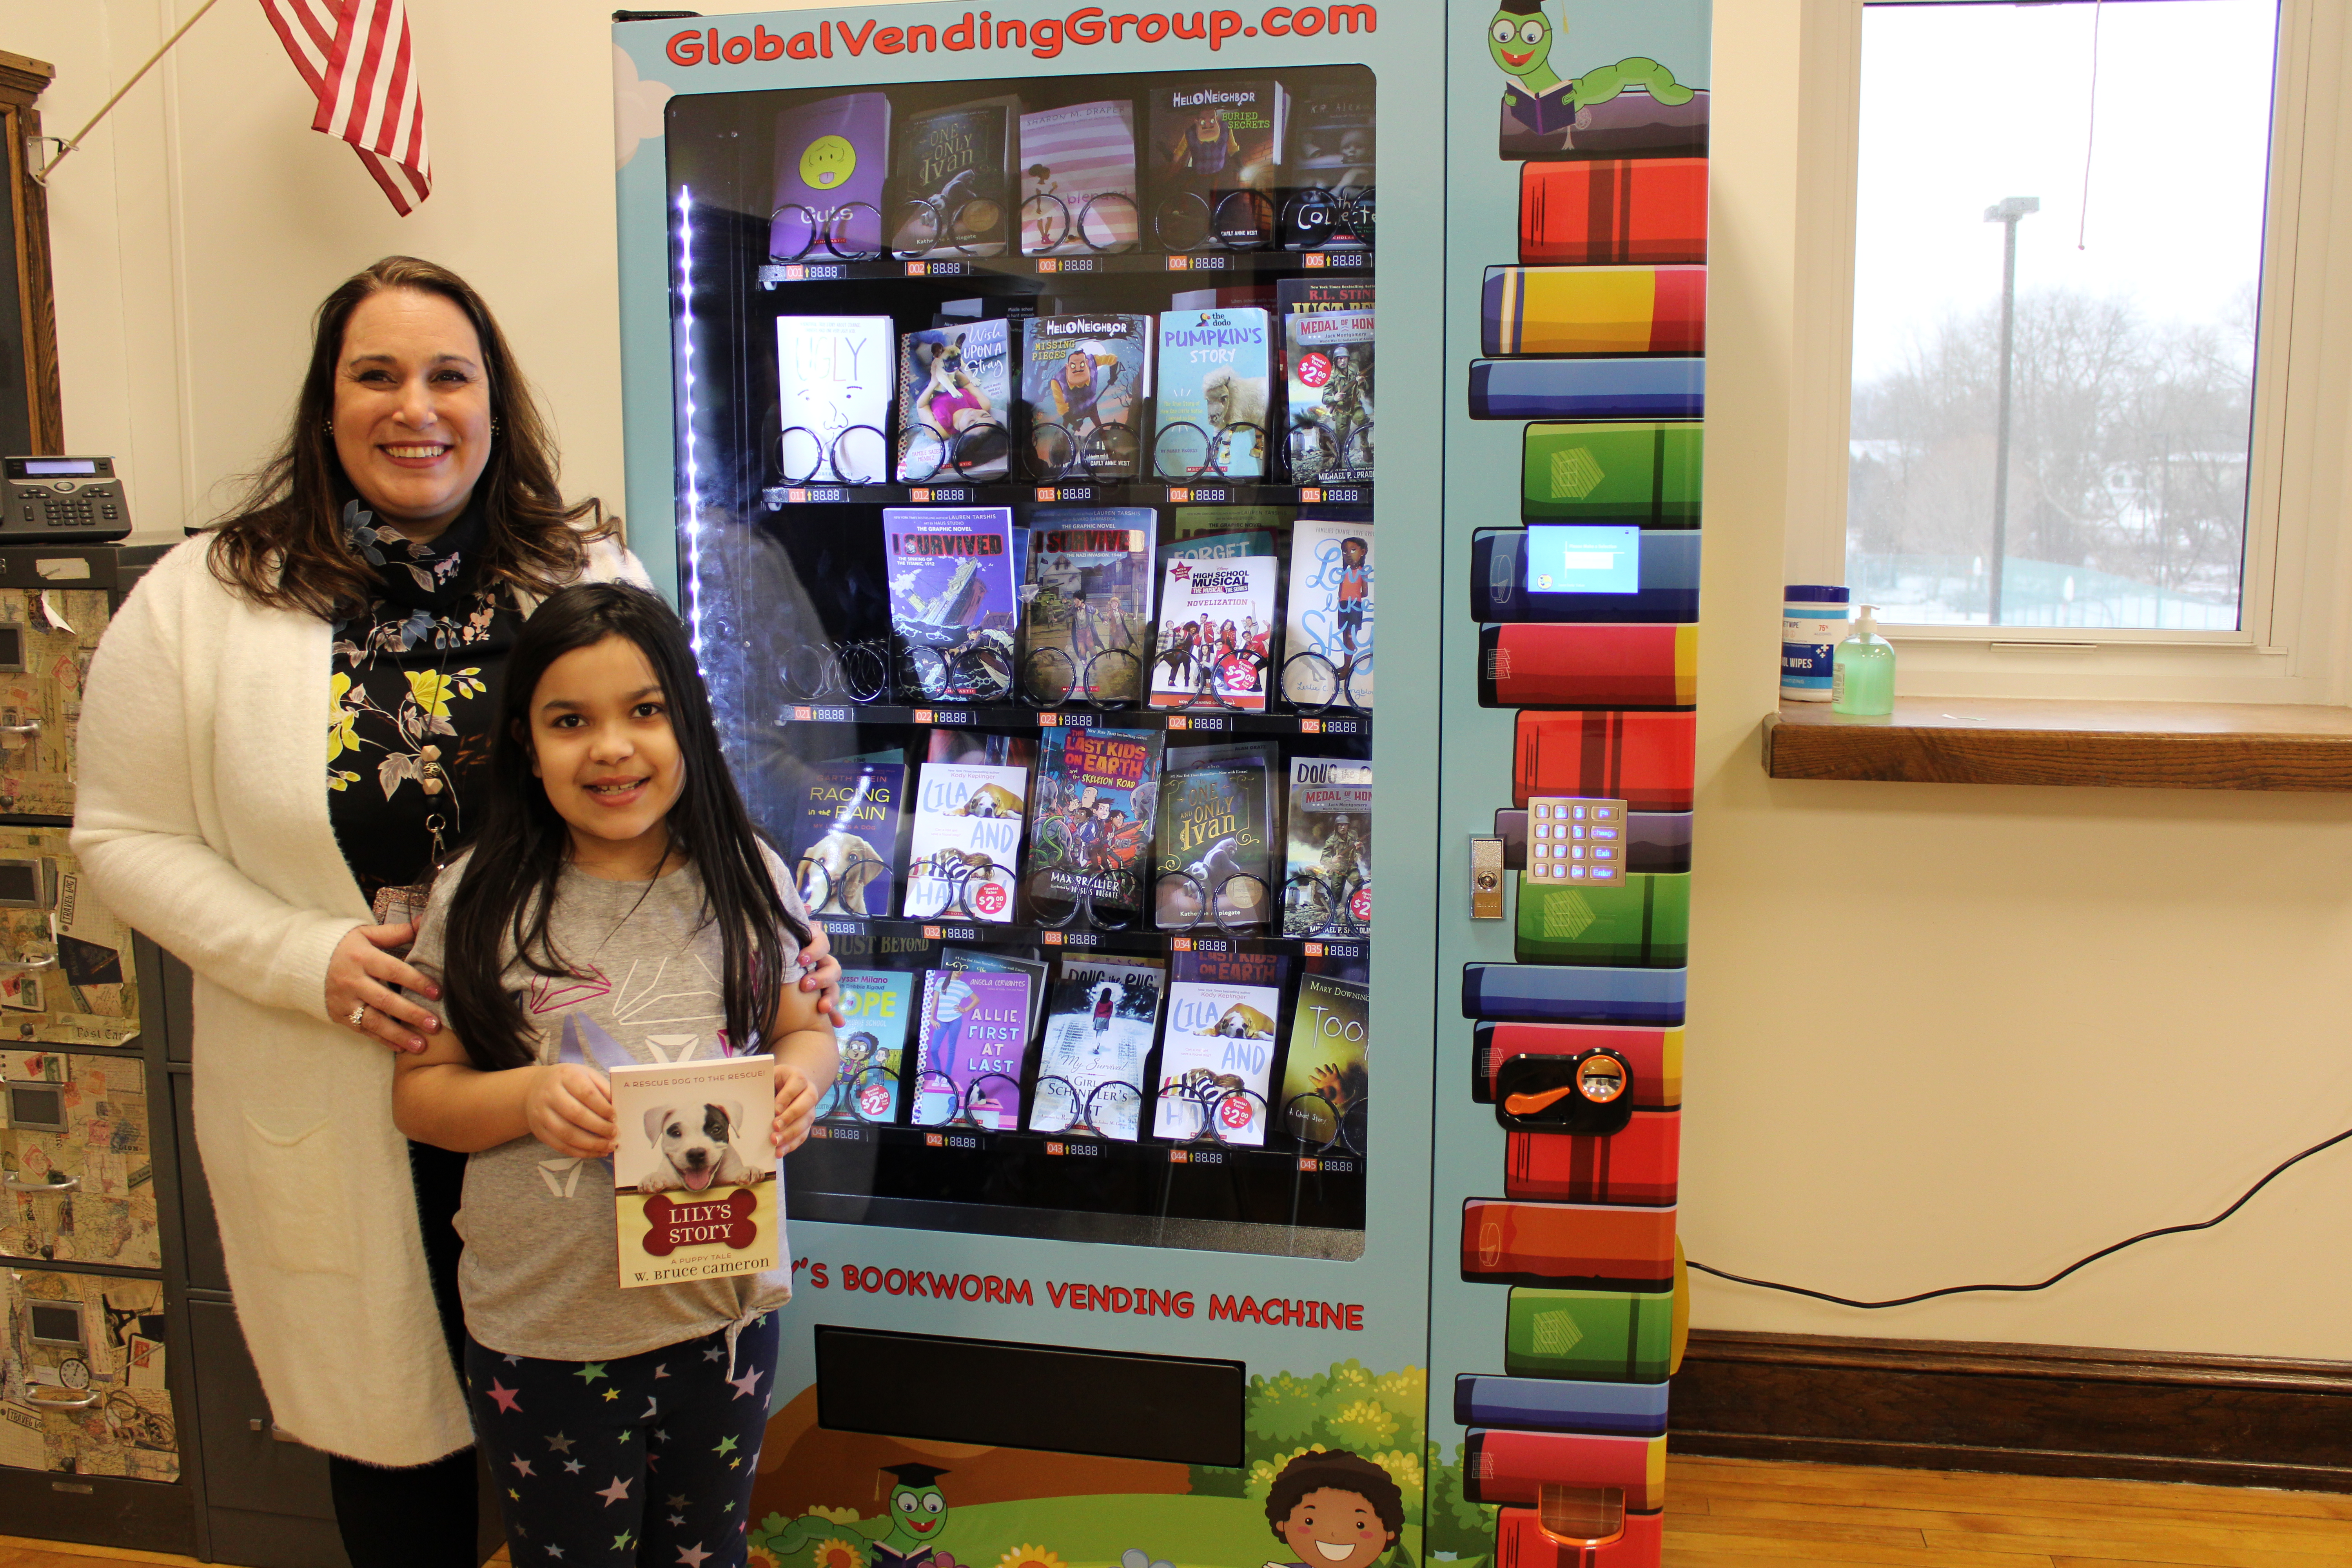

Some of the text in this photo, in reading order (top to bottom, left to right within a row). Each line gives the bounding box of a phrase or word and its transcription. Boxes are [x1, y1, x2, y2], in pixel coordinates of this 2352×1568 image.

[666, 4, 1377, 67] GlobalVendingGroup.com
[1027, 114, 1067, 126] SHARON
[1222, 112, 1258, 121] BURIED
[1228, 120, 1270, 129] SECRETS
[800, 205, 854, 224] Guts
[1307, 255, 1362, 266] 005 88.88
[909, 263, 960, 273] 002 88.88
[967, 323, 1002, 343] Wish
[1300, 319, 1338, 336] MEDAL
[1165, 327, 1262, 347] PUMPKIN'S
[964, 342, 1002, 359] UPON A
[1035, 341, 1076, 350] MISSING
[796, 337, 867, 381] UGLY
[1032, 351, 1066, 361] PIECES
[1190, 349, 1236, 363] STORY
[964, 359, 1003, 377] Stray
[1171, 490, 1224, 501] 014 88.88
[904, 534, 1003, 556] SURVIVED
[1192, 577, 1249, 587] MUSICAL
[1322, 593, 1374, 613] like
[1790, 658, 1812, 668] WIPES
[1297, 681, 1319, 691] Leslie
[1169, 718, 1222, 729] 024 88.88
[1066, 737, 1146, 760] LAST KIDS
[1065, 753, 1143, 778] ON EARTH
[1082, 774, 1113, 785] SKELETON
[1116, 778, 1136, 789] ROAD
[810, 787, 890, 802] RACING
[923, 779, 968, 813] LILA
[1189, 782, 1218, 806] ONE
[835, 806, 886, 820] RAIN
[1180, 796, 1234, 823] AND ONLY
[1540, 808, 1544, 816] 1
[1576, 809, 1582, 817] 3
[970, 820, 1014, 853] AND
[1180, 814, 1236, 851] Ivan
[1096, 890, 1118, 898] HOLGATE
[63, 892, 74, 921] TRAVEL
[880, 936, 929, 953] BEYOND
[1046, 933, 1096, 945] 033 88.88
[1310, 981, 1332, 994] MARY
[968, 1026, 1019, 1040] FIRST
[982, 1043, 1004, 1056] AT
[968, 1058, 1014, 1073] LAST
[1060, 1054, 1128, 1073] My Survival
[728, 1070, 766, 1080] RESCUE!
[1074, 1076, 1097, 1088] GIRL
[1289, 1107, 1293, 1116] A
[1296, 1110, 1310, 1120] Ghost
[1171, 1152, 1222, 1163] 044 88.88
[680, 1255, 709, 1265] PUPPY
[634, 1272, 649, 1282] W.
[841, 1263, 1034, 1306] BOOKWORM
[1046, 1281, 1195, 1318] VENDING
[1208, 1294, 1365, 1330] MACHINE
